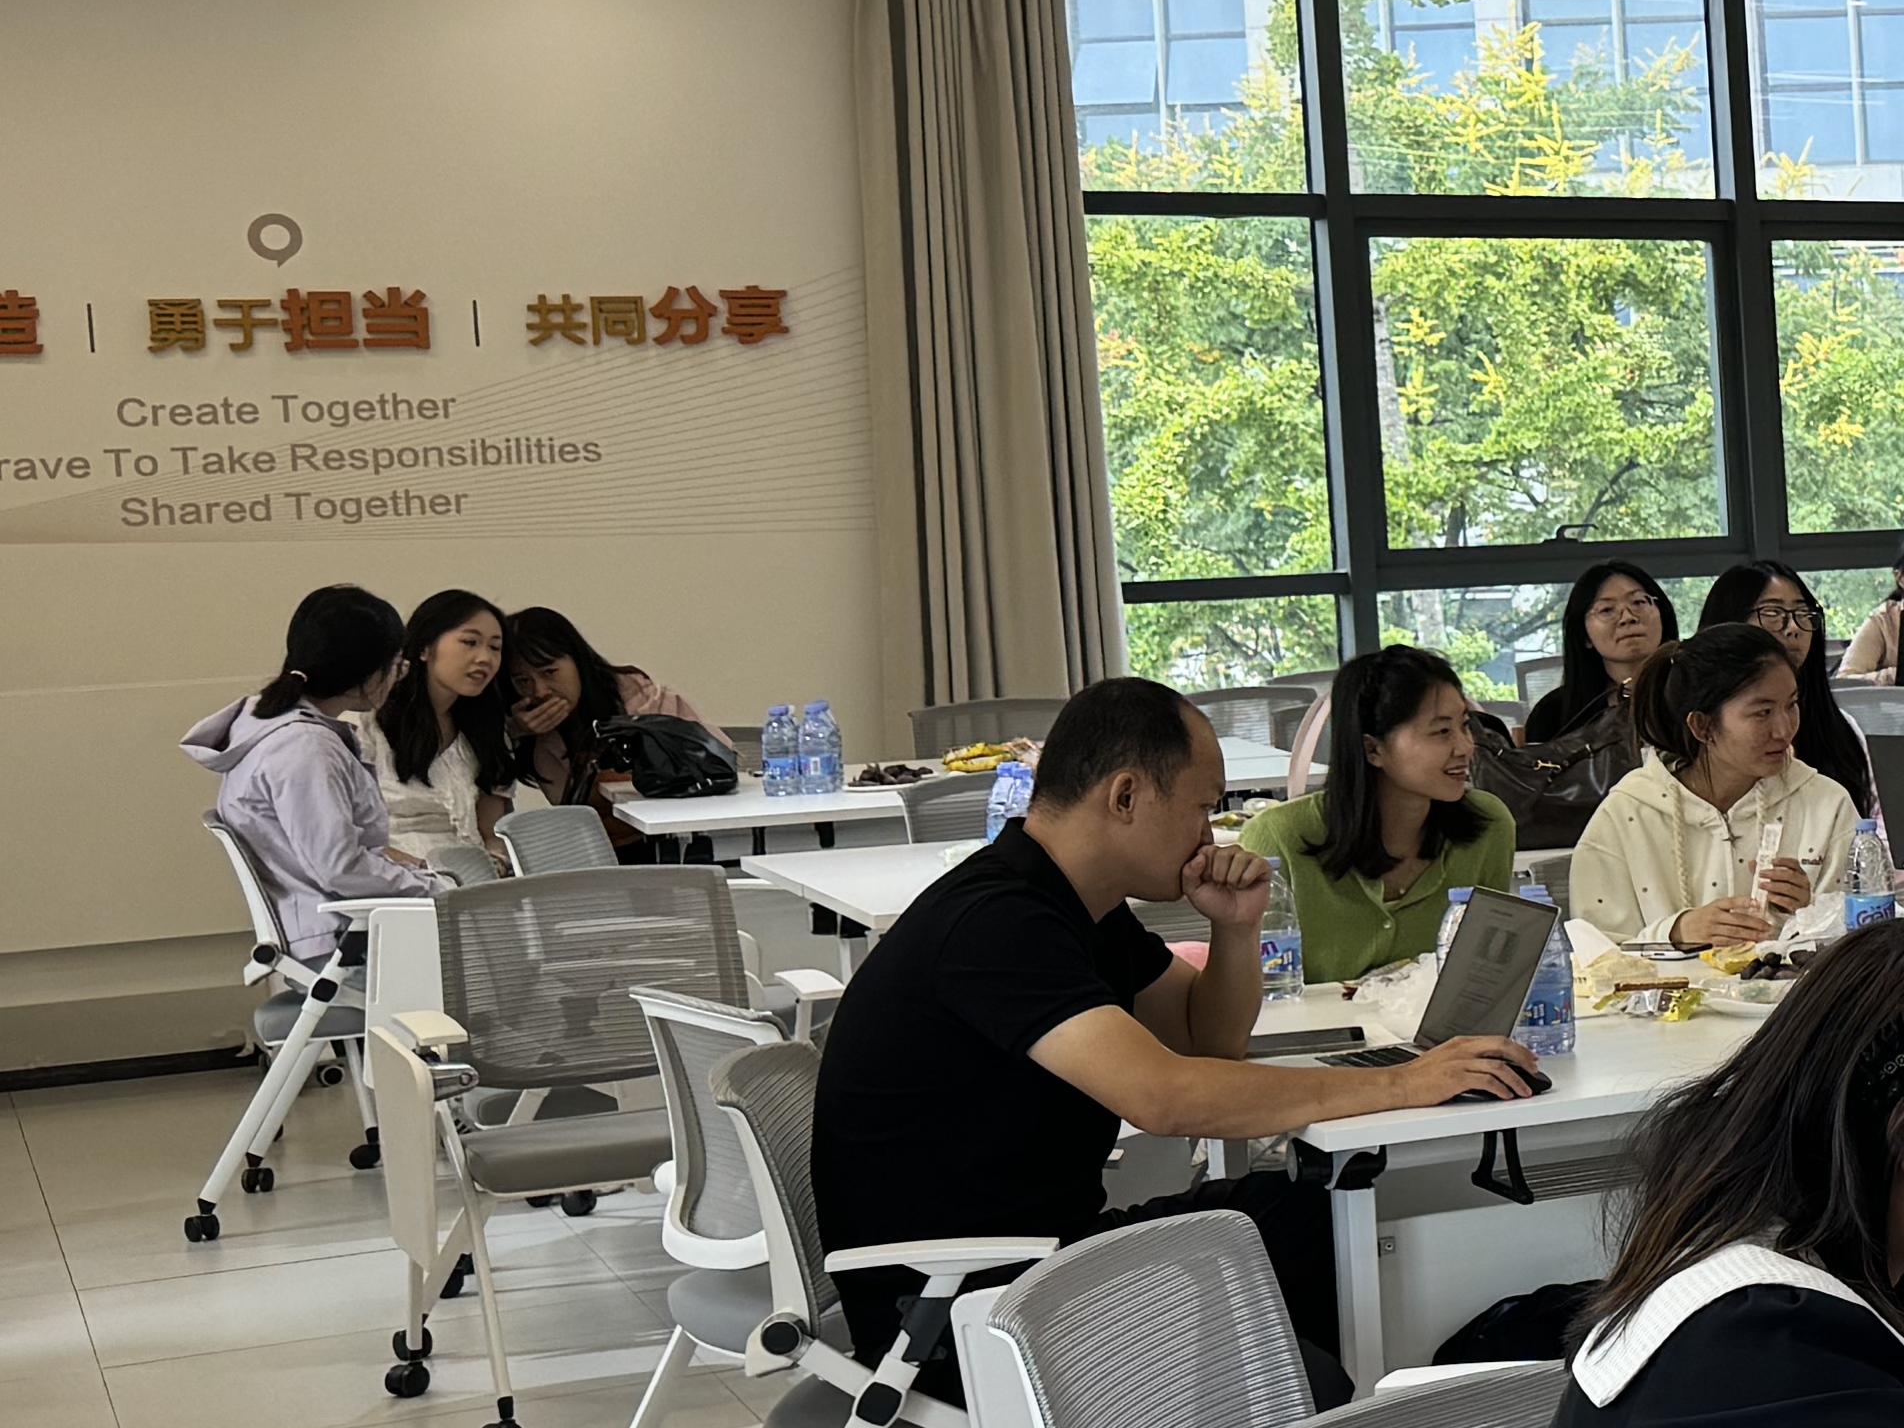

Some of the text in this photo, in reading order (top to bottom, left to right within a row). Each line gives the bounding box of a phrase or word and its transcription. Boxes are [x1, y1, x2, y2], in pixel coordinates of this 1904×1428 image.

[146, 286, 431, 354] 勇于担当
[526, 284, 789, 348] 共同分享
[116, 391, 457, 429] Create Together
[103, 448, 159, 478] To
[170, 446, 276, 476] Take
[290, 436, 603, 478] Responsibilities
[120, 490, 469, 527] Shared Together
